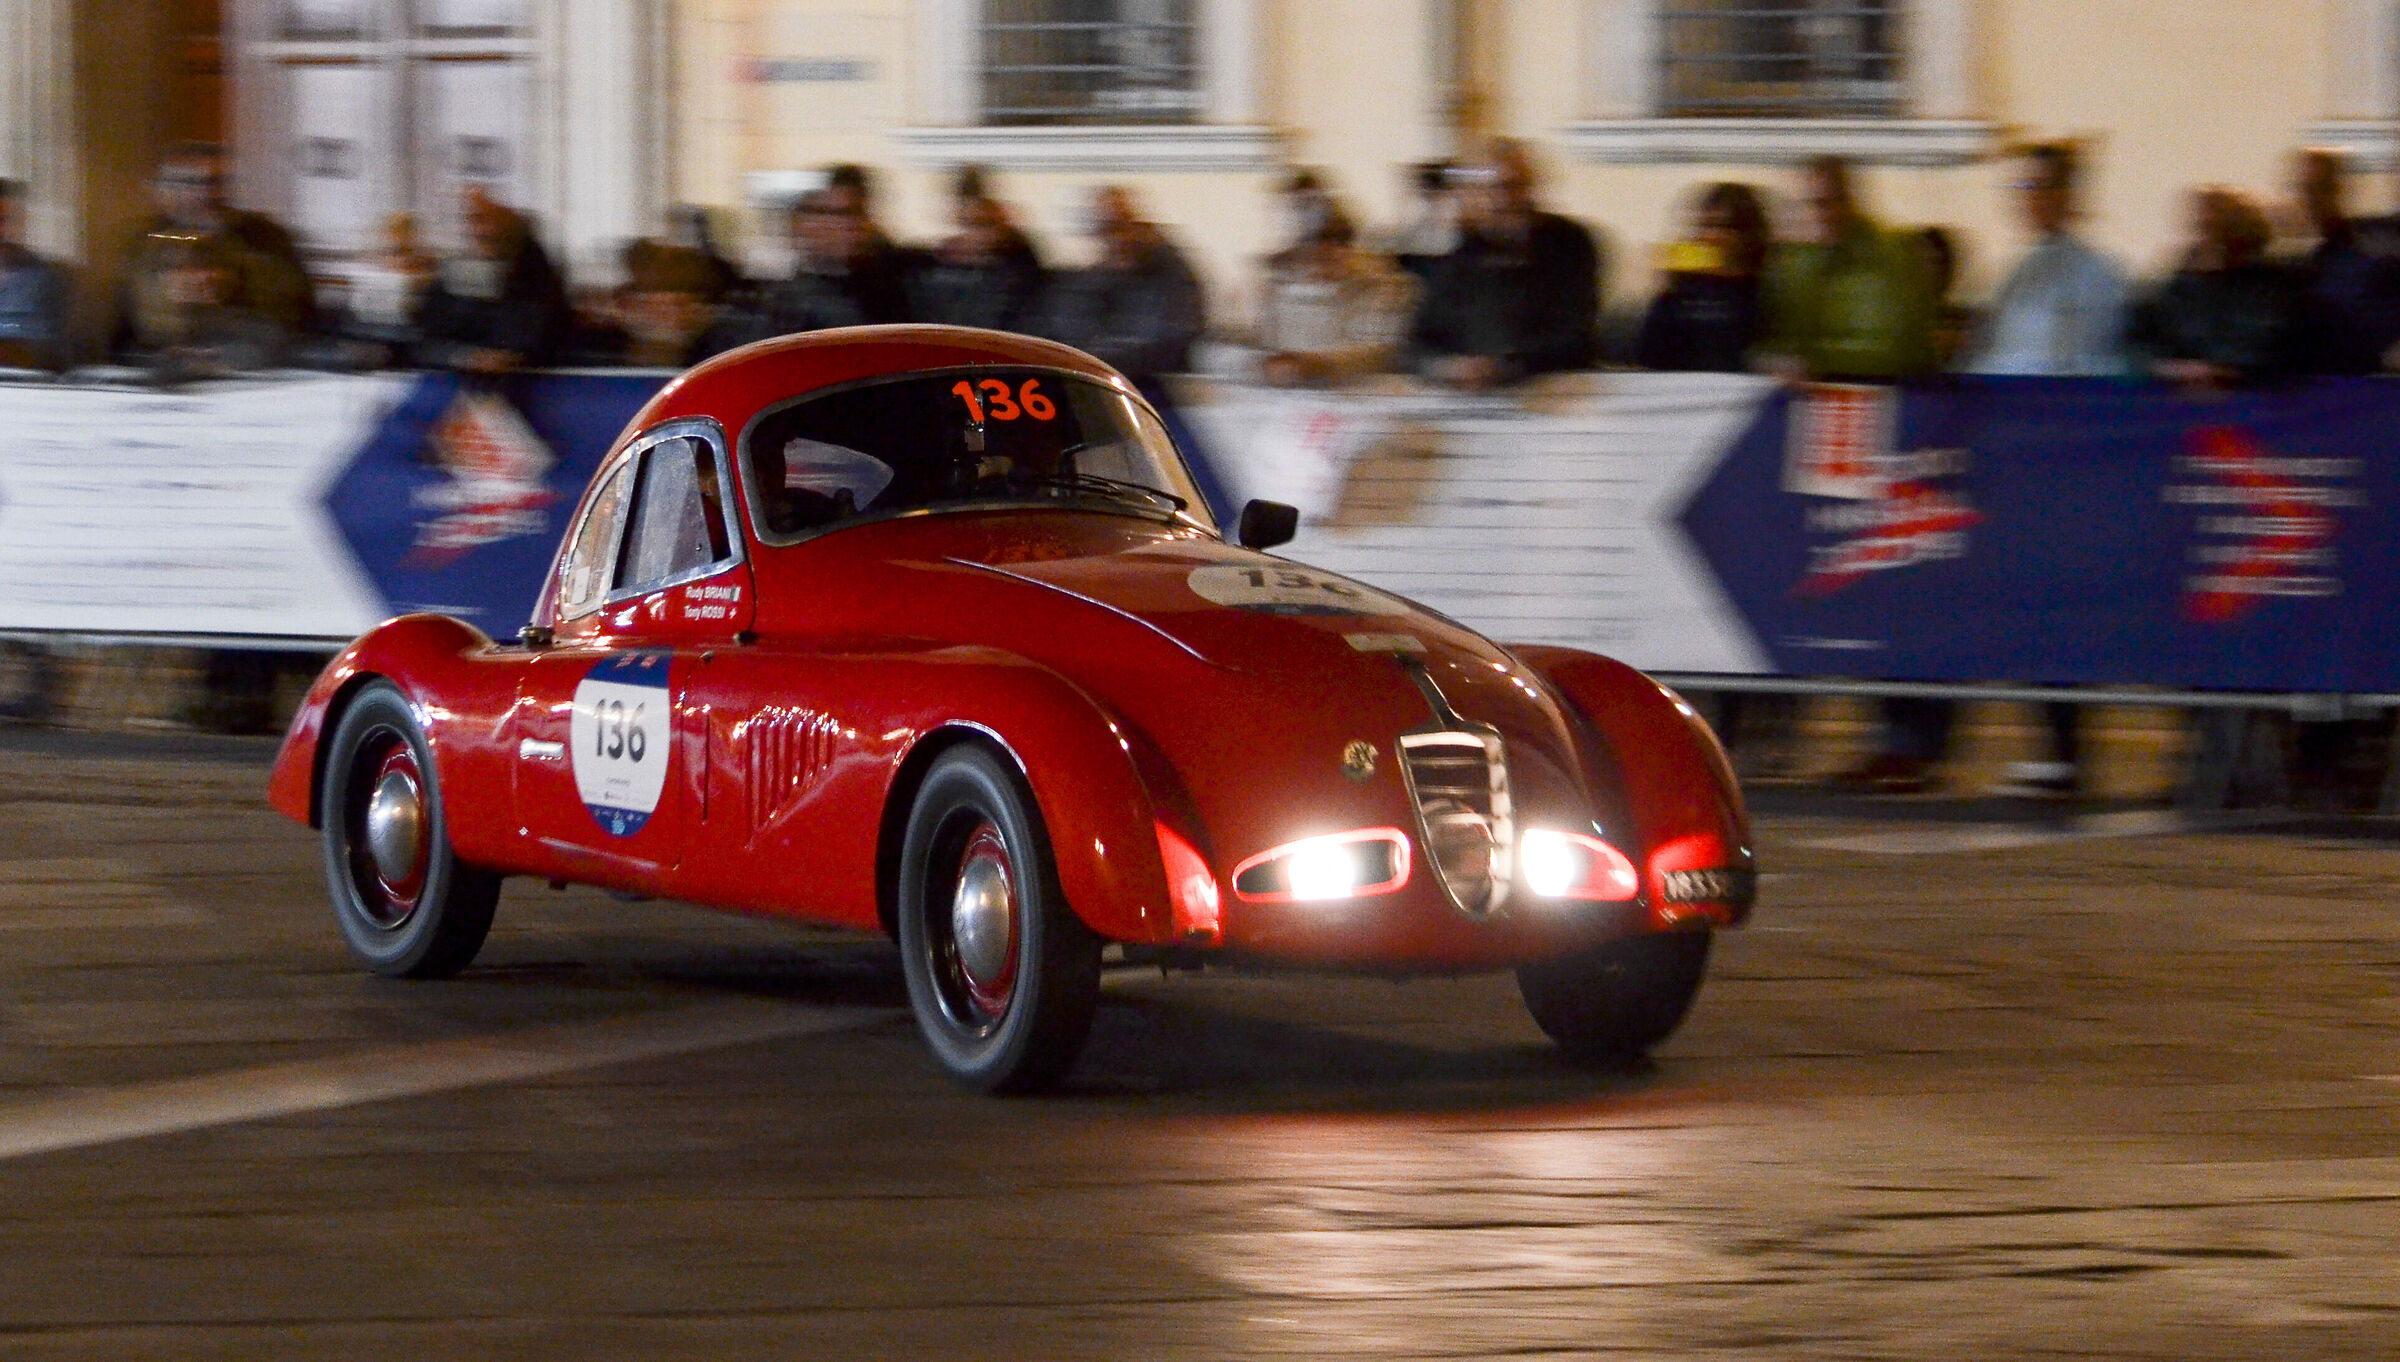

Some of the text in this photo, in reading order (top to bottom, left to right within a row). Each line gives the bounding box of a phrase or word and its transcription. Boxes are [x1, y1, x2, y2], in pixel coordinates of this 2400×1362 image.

[951, 378, 1056, 422] 136
[685, 586, 704, 601] Rudy
[684, 605, 725, 621] Tony ROSSI
[596, 699, 645, 763] 136
